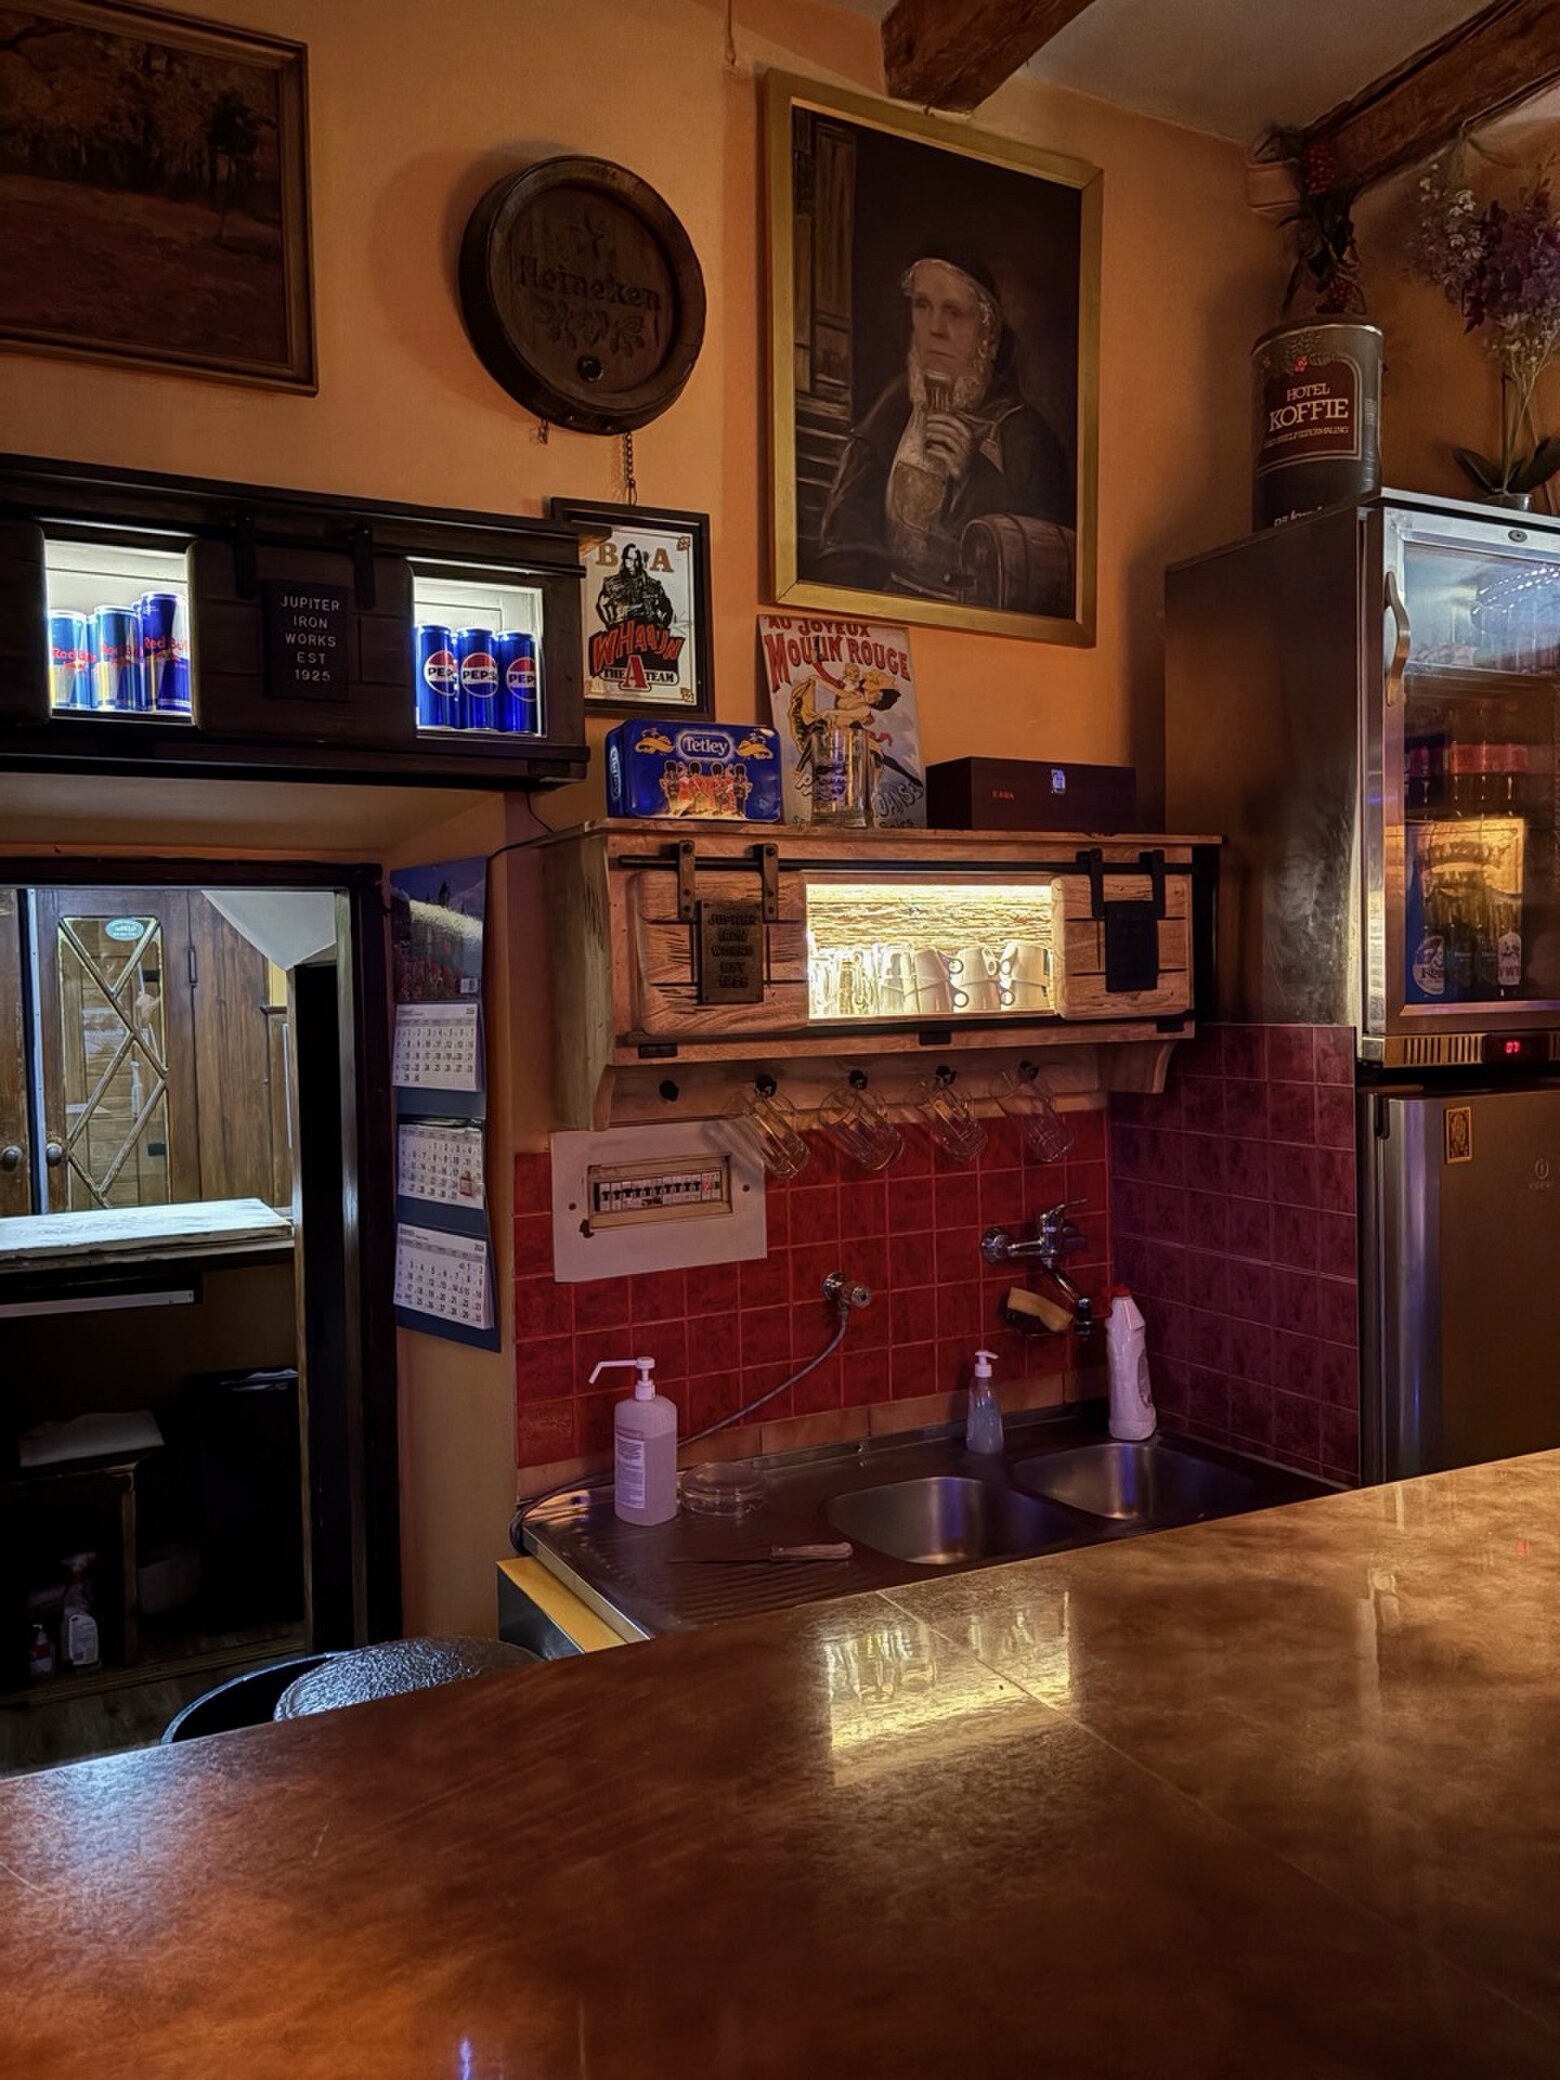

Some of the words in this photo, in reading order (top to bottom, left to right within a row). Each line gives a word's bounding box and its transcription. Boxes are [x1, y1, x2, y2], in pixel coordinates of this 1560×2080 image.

[519, 255, 661, 311] Heineken
[1286, 382, 1330, 402] HOTEL
[1268, 398, 1349, 432] KOFFIE
[280, 595, 340, 611] JUPITER
[293, 615, 328, 629] IRON
[797, 617, 871, 638] JOYEUX
[285, 633, 337, 648] WORKS
[297, 651, 326, 665] EST
[846, 637, 911, 682] ROUGE
[294, 669, 332, 682] 1925
[603, 667, 625, 680] THE
[623, 655, 649, 689] A
[645, 671, 675, 683] TEAM
[683, 736, 728, 756] Tetley
